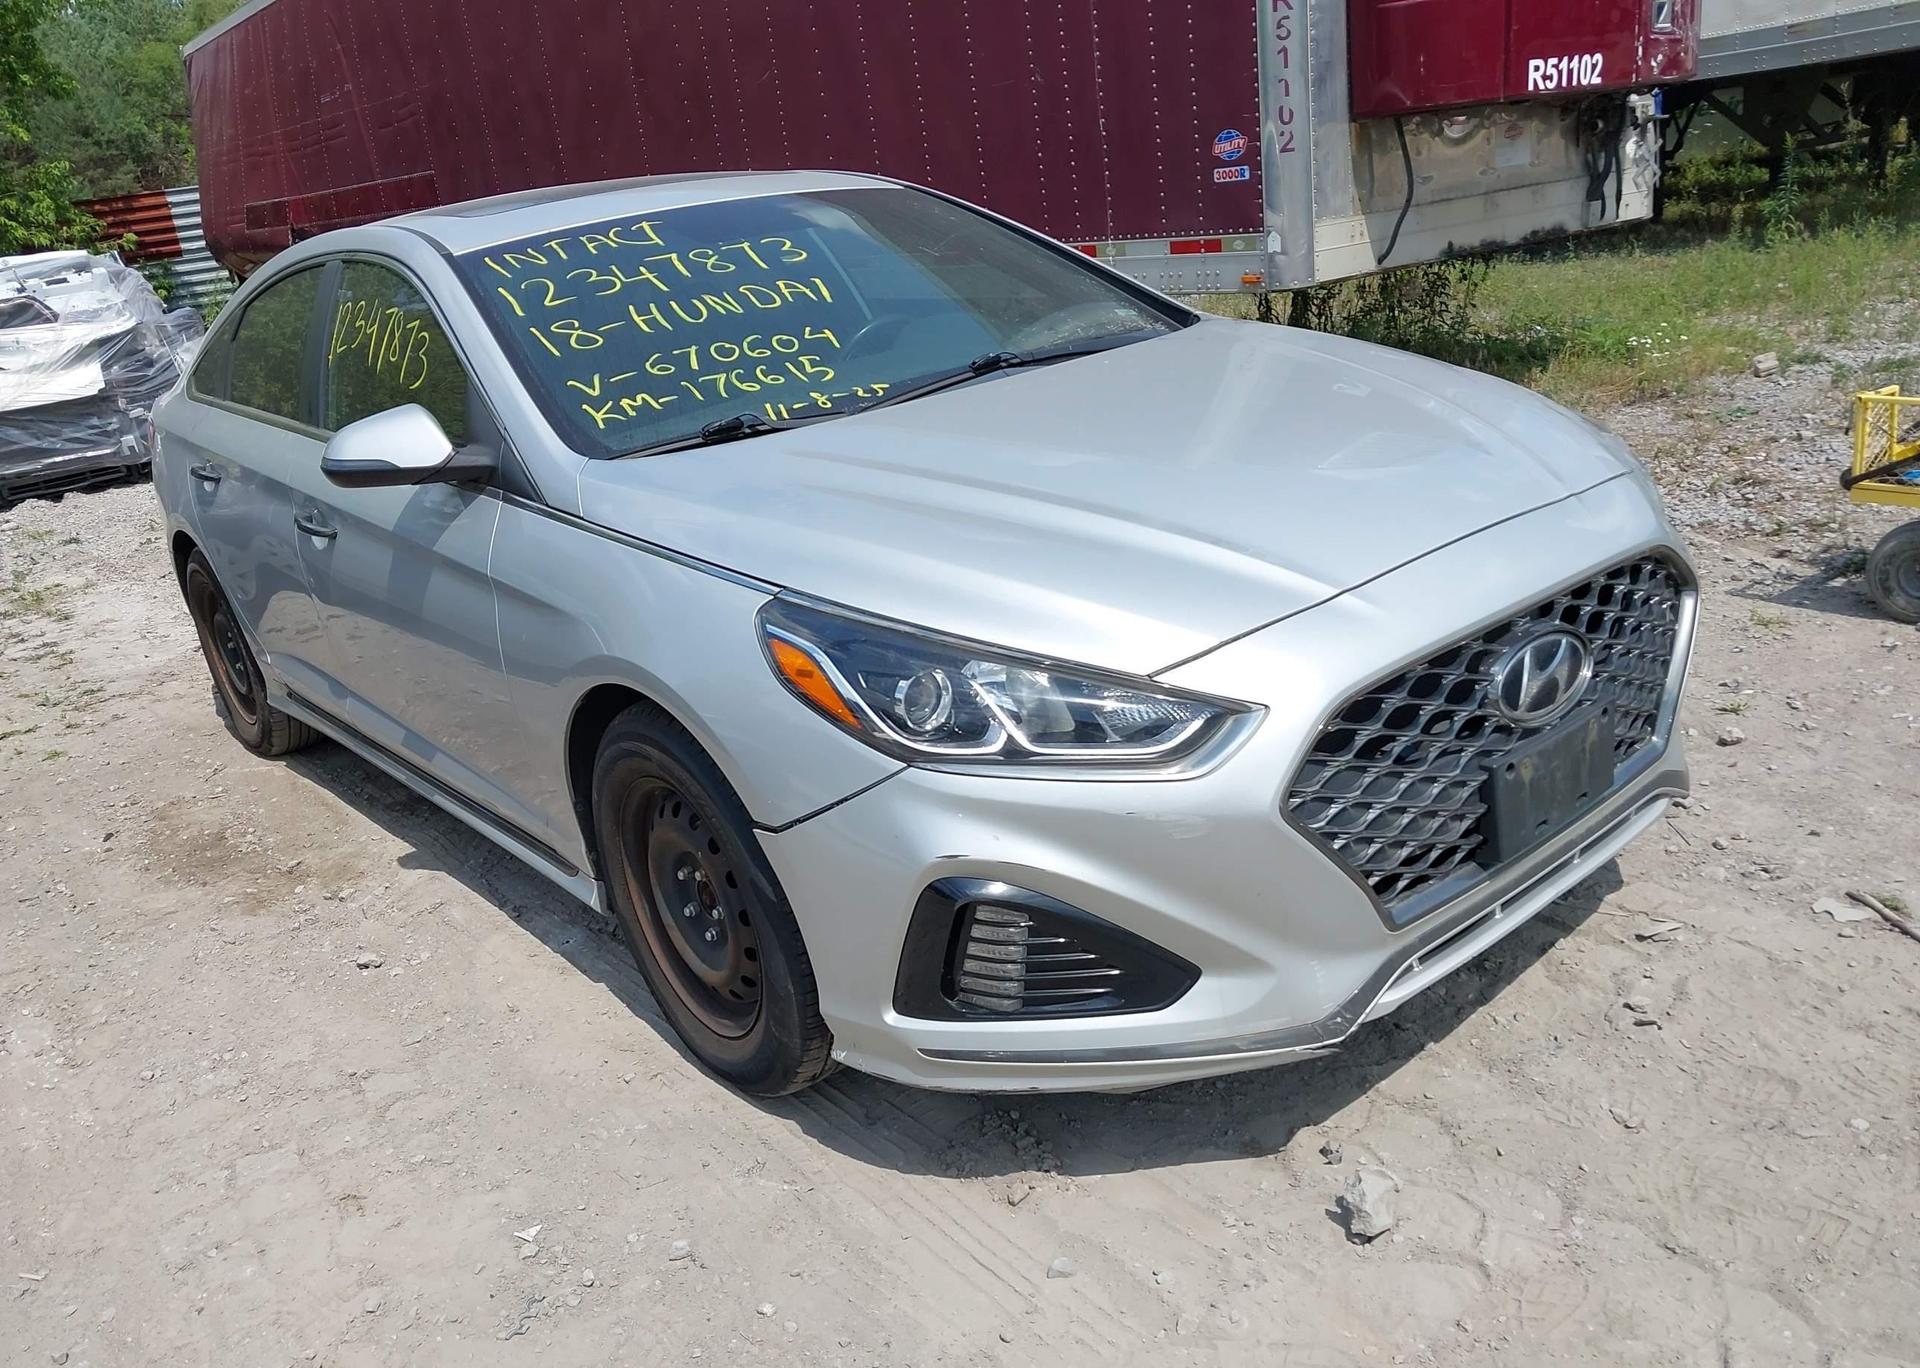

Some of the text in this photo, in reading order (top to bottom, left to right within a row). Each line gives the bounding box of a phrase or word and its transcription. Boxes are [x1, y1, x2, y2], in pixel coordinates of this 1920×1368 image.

[1528, 53, 1603, 91] R51102
[1214, 139, 1245, 154] UTILITY
[1215, 168, 1246, 181] 3000R
[483, 220, 664, 277] INTACT
[497, 236, 808, 316] 12347873
[328, 298, 430, 389] 12347873
[529, 276, 833, 357] 18-HUNDAI
[566, 326, 841, 397] V-670604
[580, 355, 835, 430] KM-176615
[764, 383, 891, 422] 11-8-25
